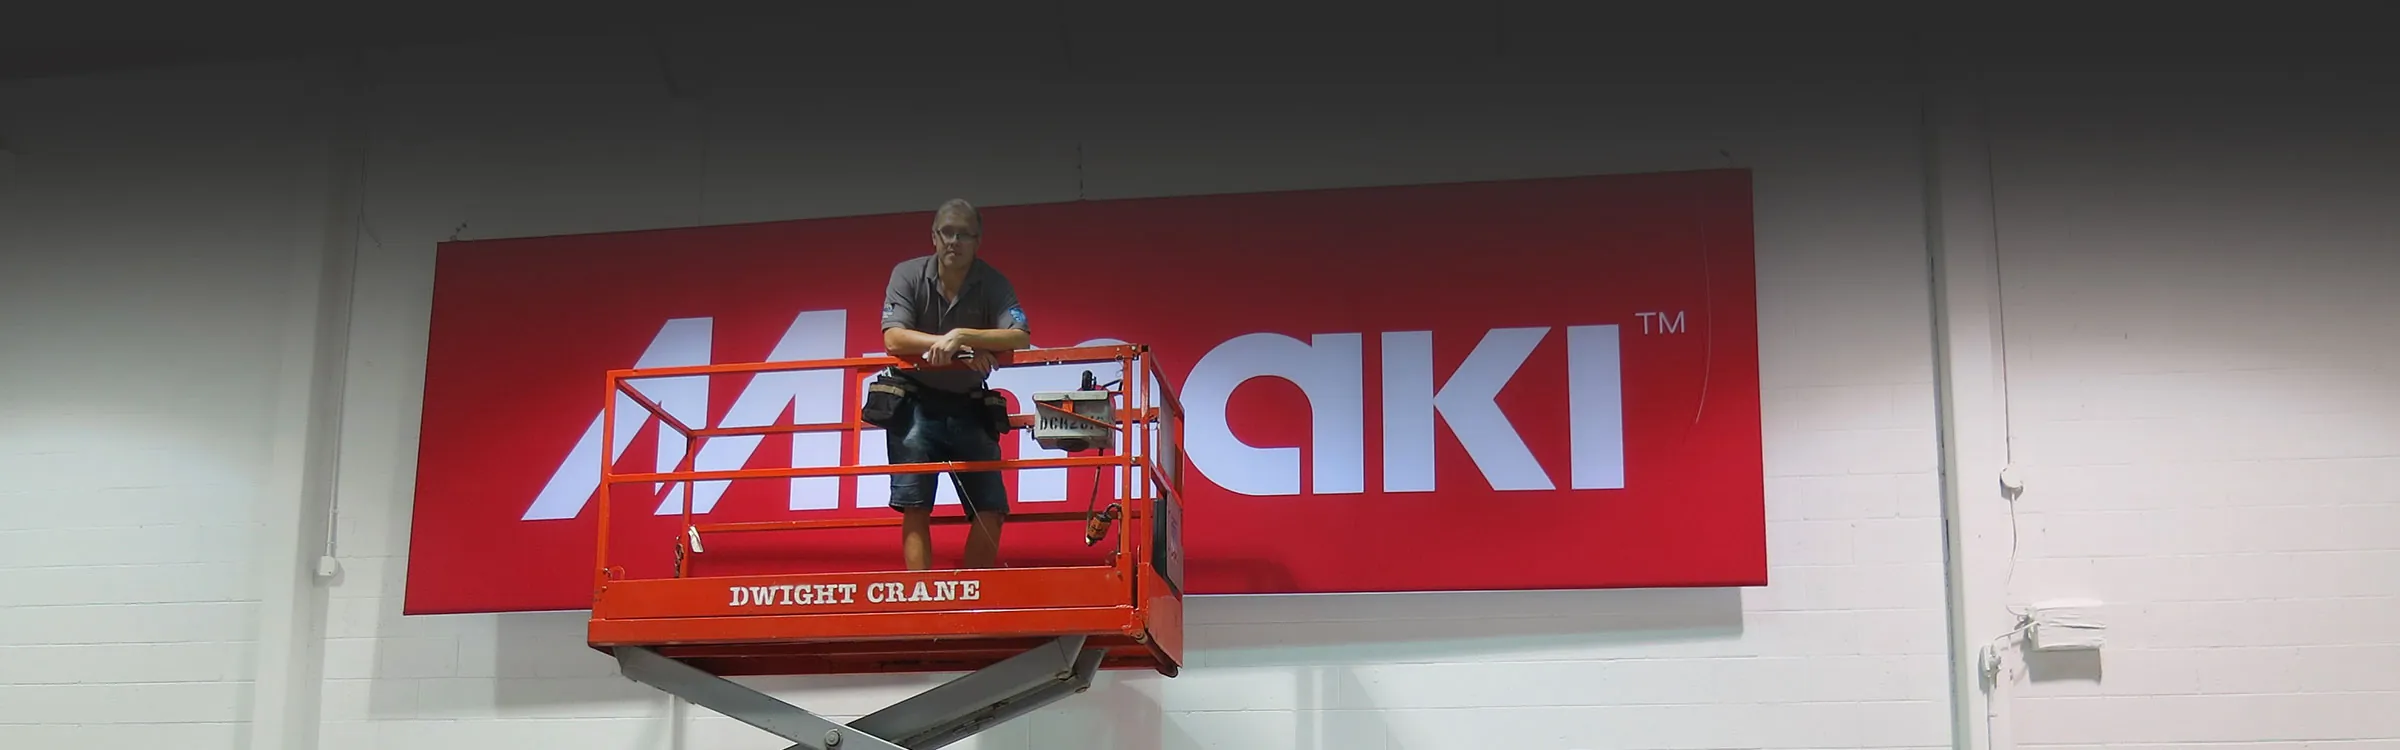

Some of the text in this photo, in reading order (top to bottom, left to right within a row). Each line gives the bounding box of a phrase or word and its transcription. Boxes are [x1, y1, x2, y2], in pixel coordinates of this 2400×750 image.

[1635, 311, 1685, 335] TM
[729, 580, 980, 606] DWIGHT CRANE
